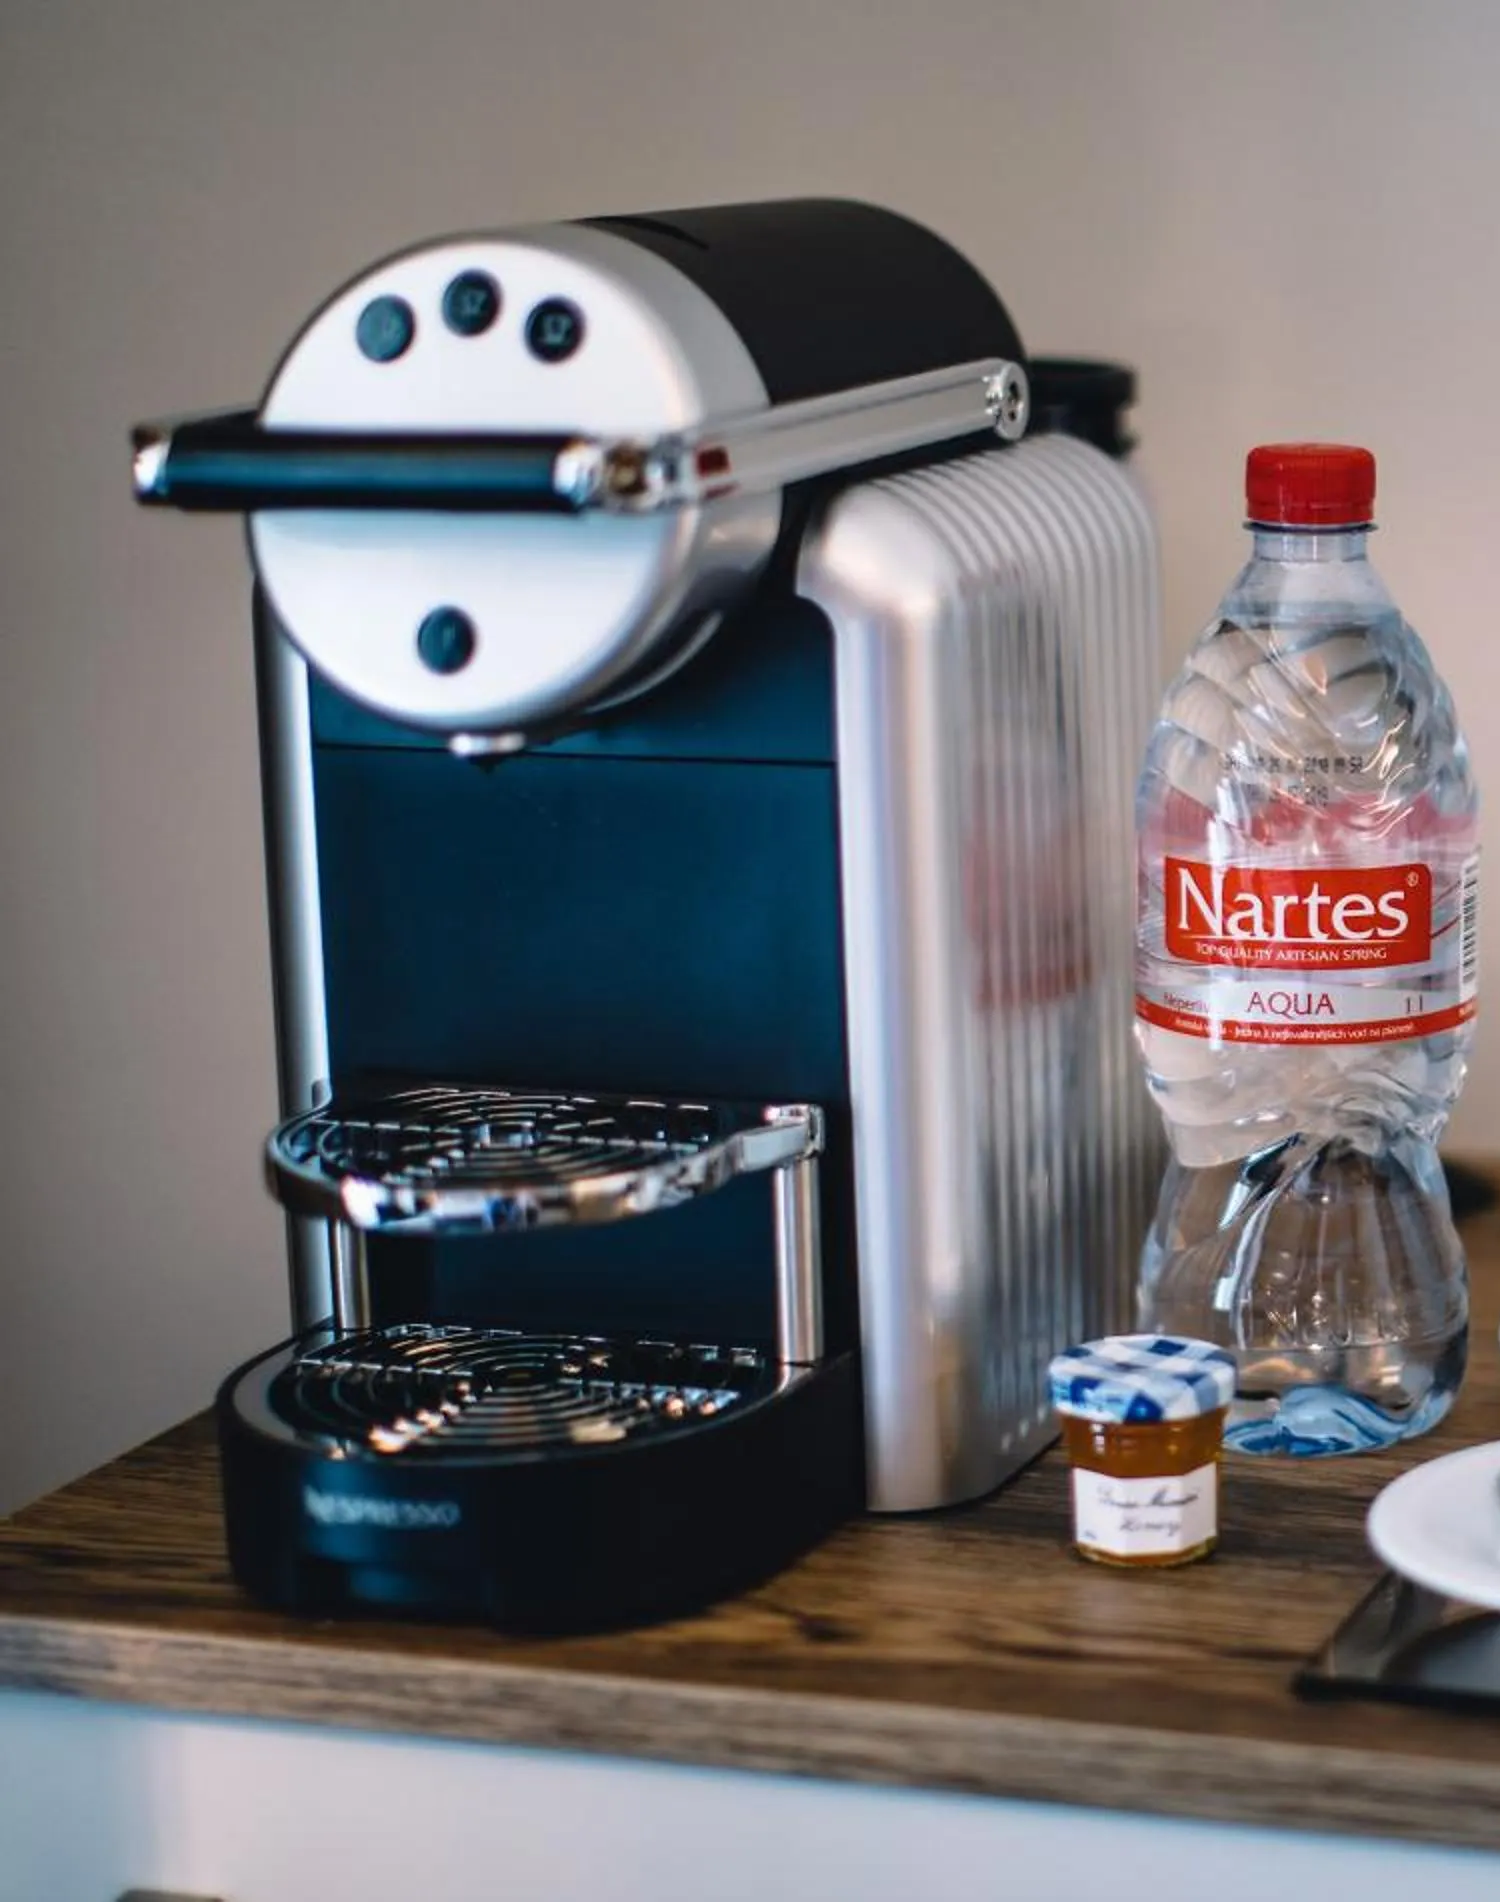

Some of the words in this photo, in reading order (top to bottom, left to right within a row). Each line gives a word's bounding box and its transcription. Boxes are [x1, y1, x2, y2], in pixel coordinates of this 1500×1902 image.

[1178, 867, 1410, 941] Nartes
[1220, 945, 1272, 961] QUALITY
[1276, 949, 1339, 962] ARTESIAN
[1343, 947, 1387, 961] SPRING
[1247, 991, 1335, 1019] AQUA
